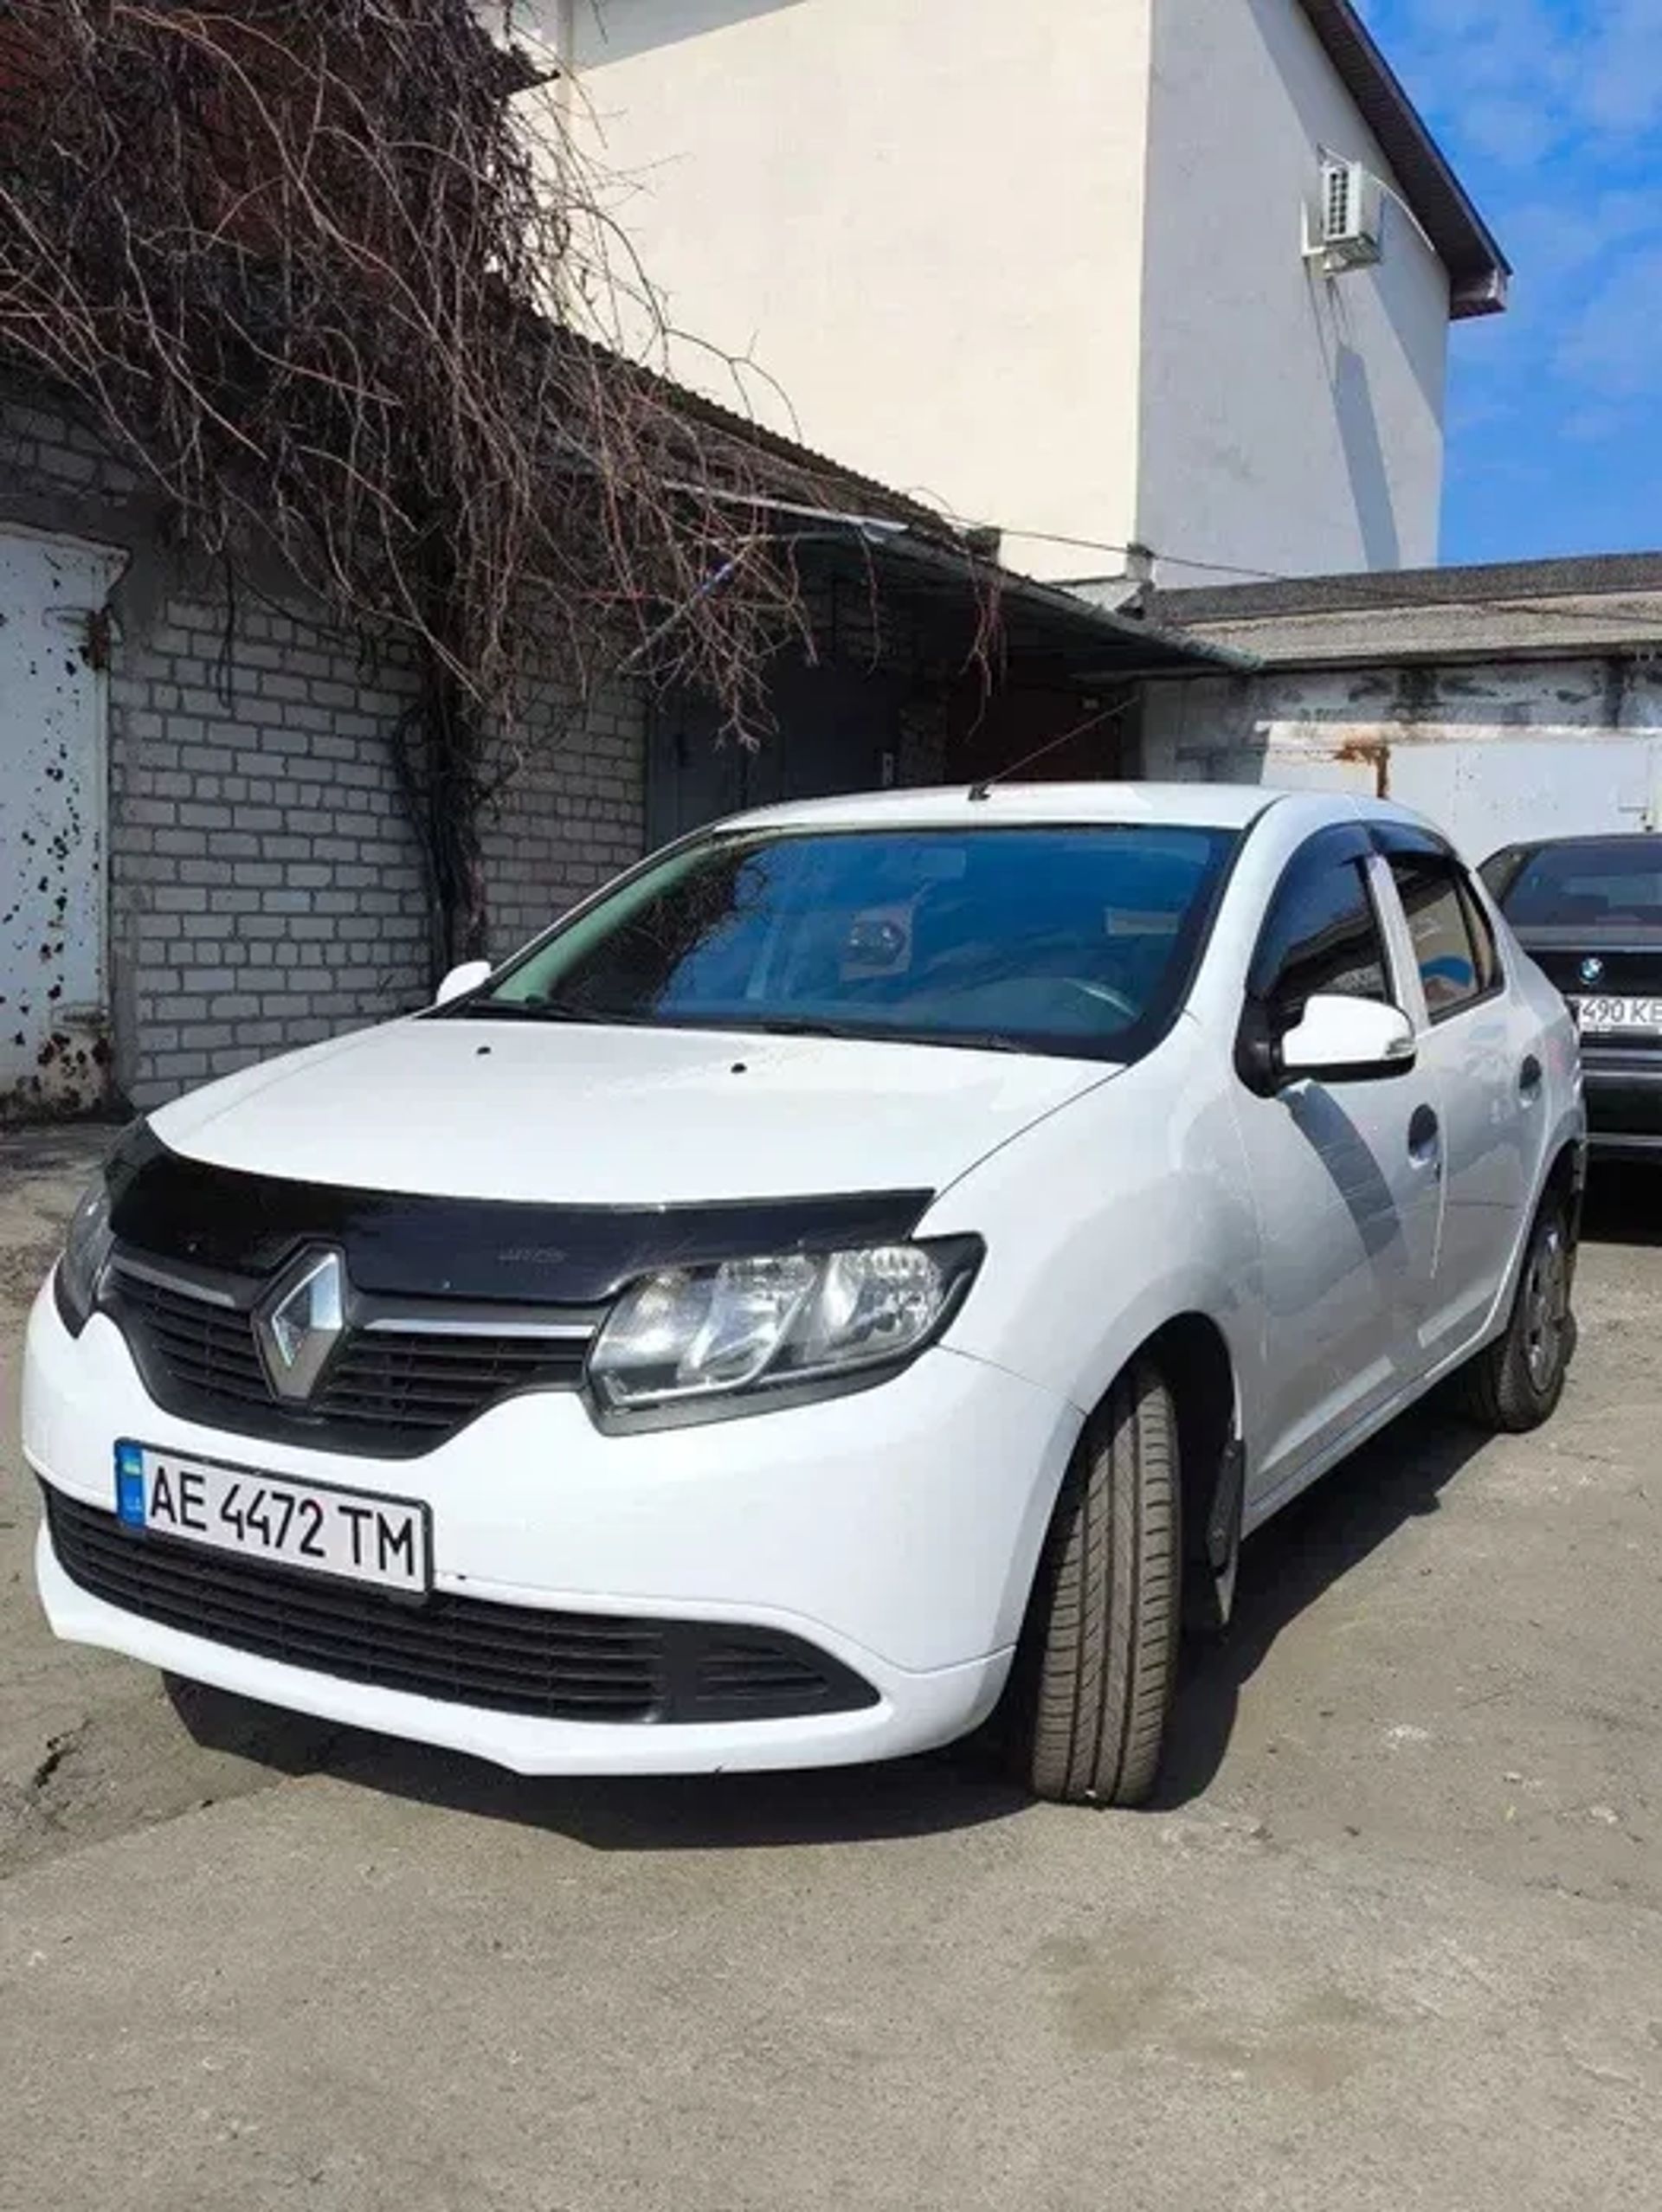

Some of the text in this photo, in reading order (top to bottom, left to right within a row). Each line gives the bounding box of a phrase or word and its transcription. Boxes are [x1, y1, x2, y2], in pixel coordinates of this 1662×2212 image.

[1569, 999, 1626, 1022] 490
[151, 1466, 416, 1577] AE 4472 TM
